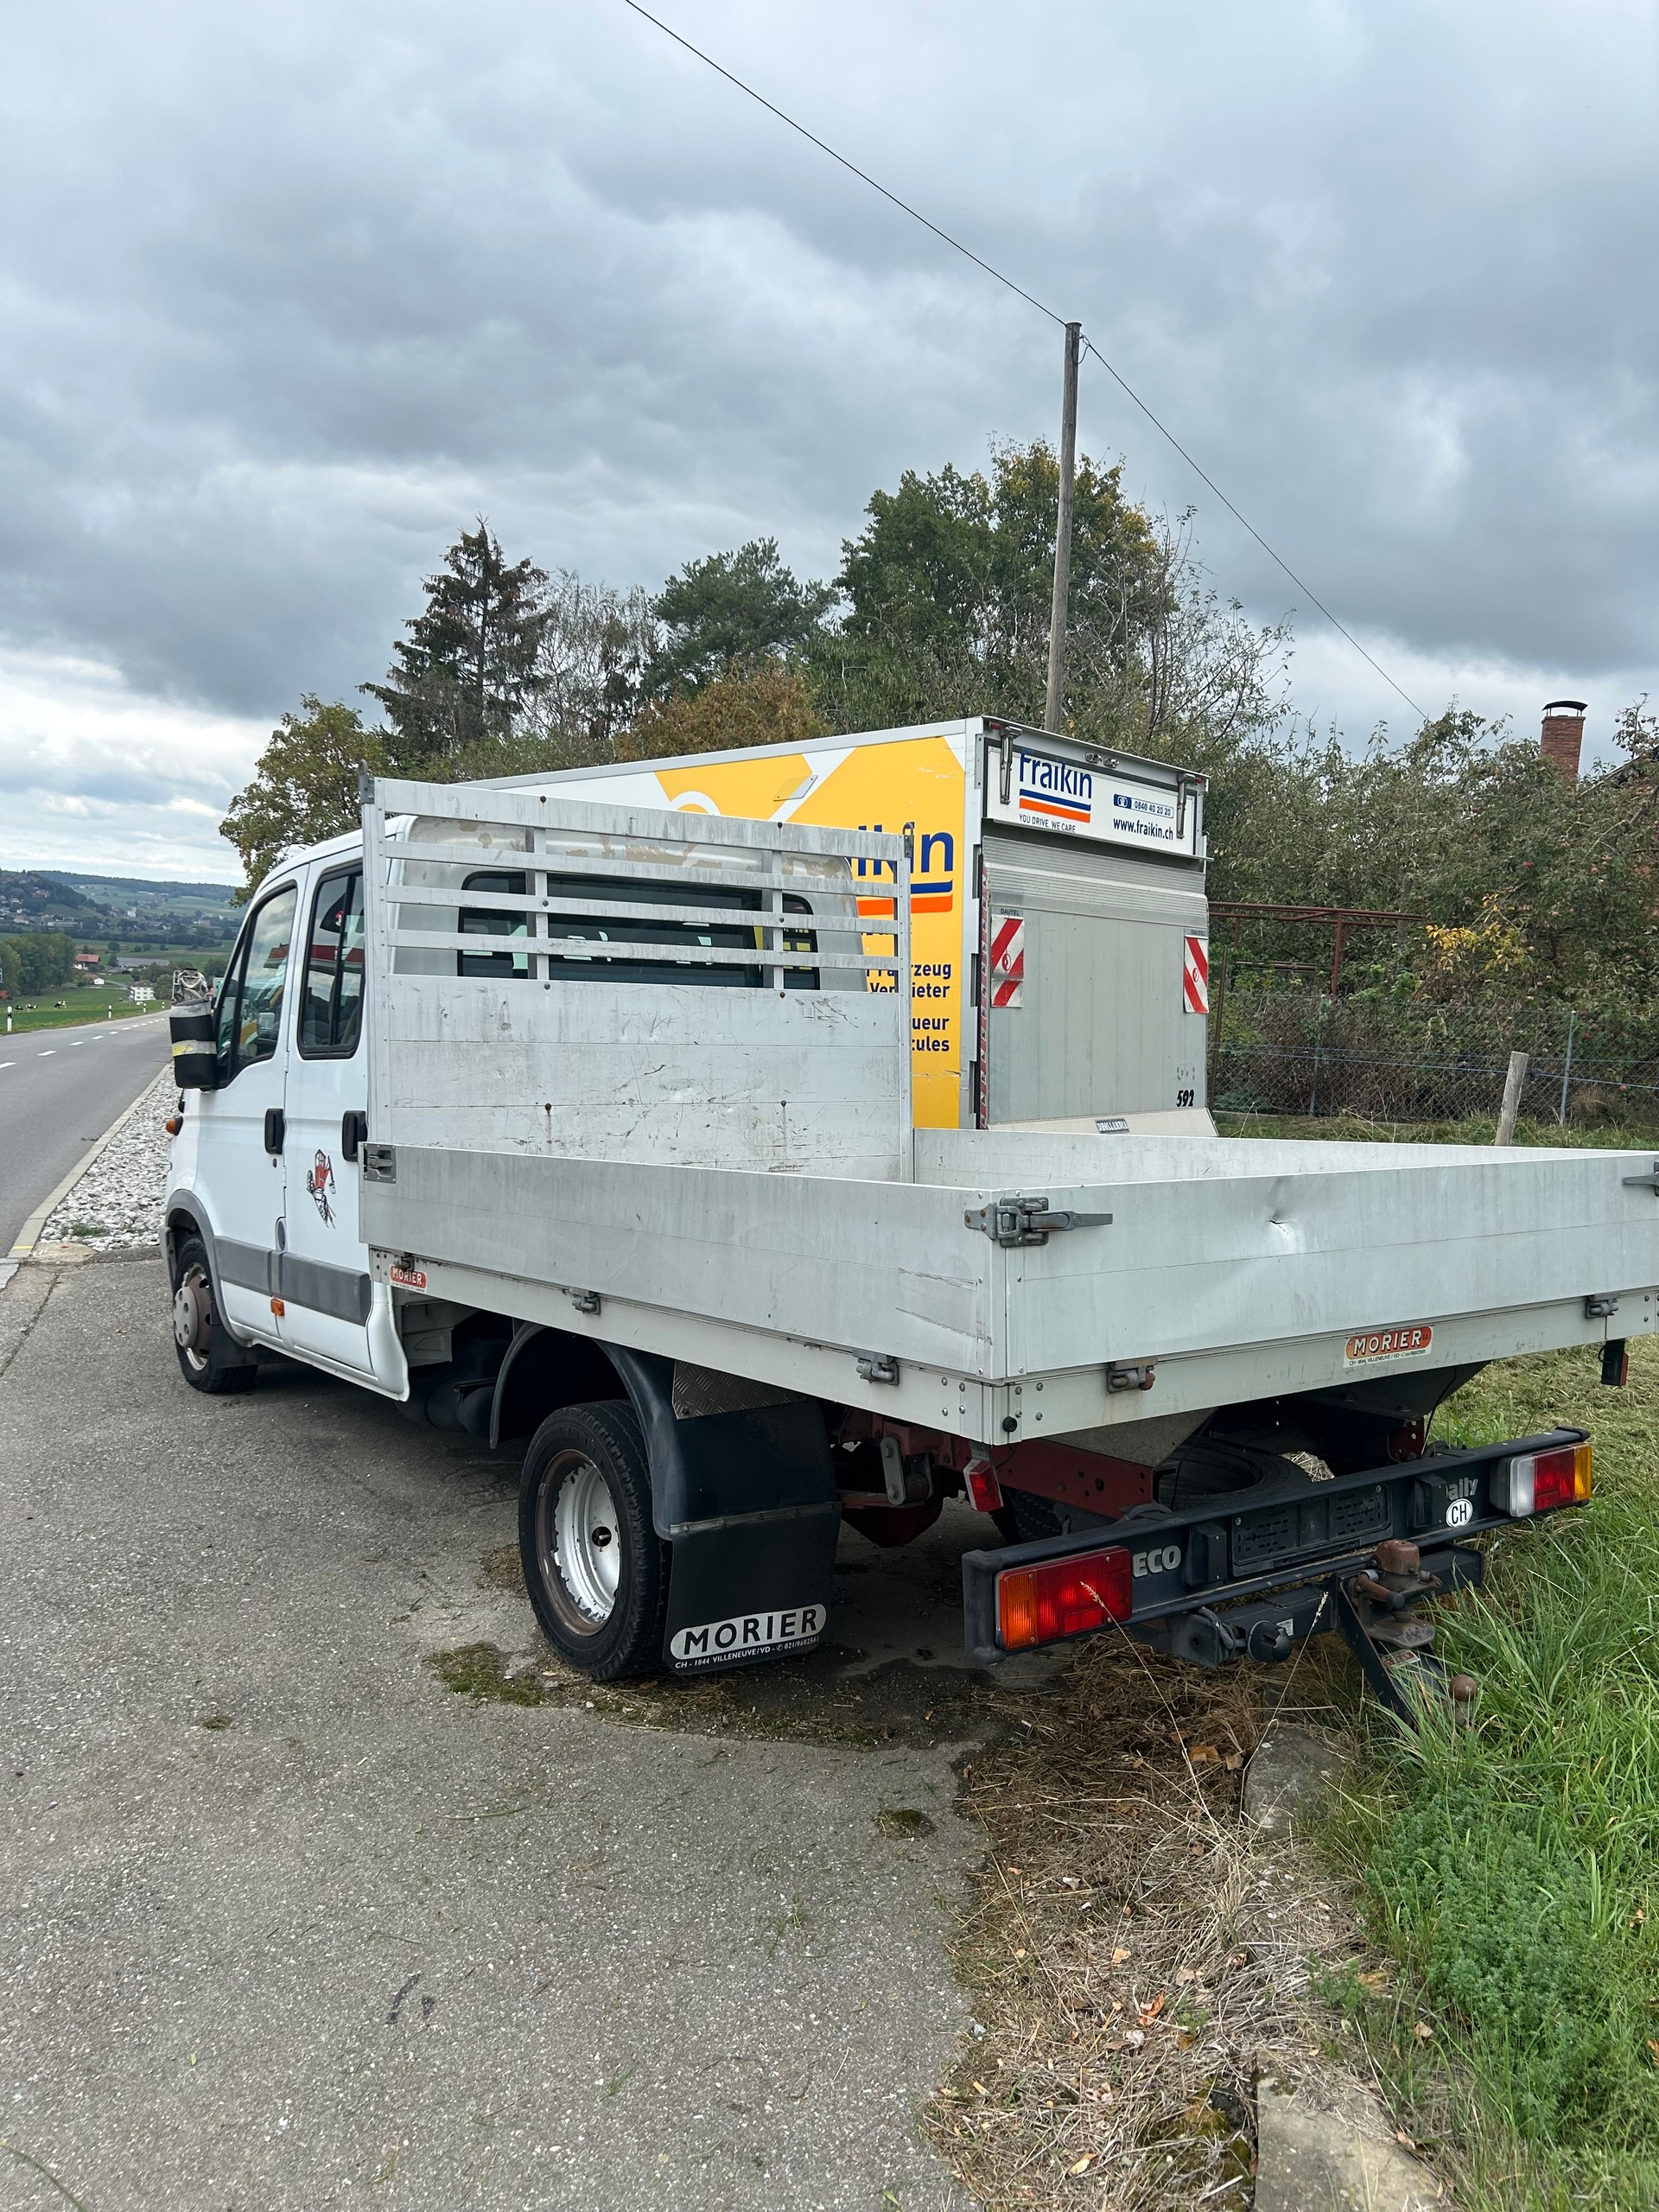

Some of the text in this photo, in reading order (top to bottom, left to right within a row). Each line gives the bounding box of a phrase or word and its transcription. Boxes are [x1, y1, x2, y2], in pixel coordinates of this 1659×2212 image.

[1020, 747, 1092, 799] Fraikin
[1149, 804, 1155, 813] 40
[1157, 805, 1163, 815] 20
[1165, 807, 1171, 817] 20
[1019, 813, 1031, 823] YOU
[1052, 820, 1060, 830] WE
[1061, 823, 1076, 833] CARE
[1113, 817, 1173, 841] www.fraikin.ch
[1176, 1089, 1194, 1107] 592
[392, 1268, 423, 1286] MORIER
[1353, 1330, 1422, 1357] MORIER
[1446, 1477, 1478, 1501] aily
[1452, 1503, 1467, 1525] CH
[1132, 1544, 1181, 1578] ECO
[683, 1608, 817, 1656] MORIER
[695, 1657, 710, 1667] 1844
